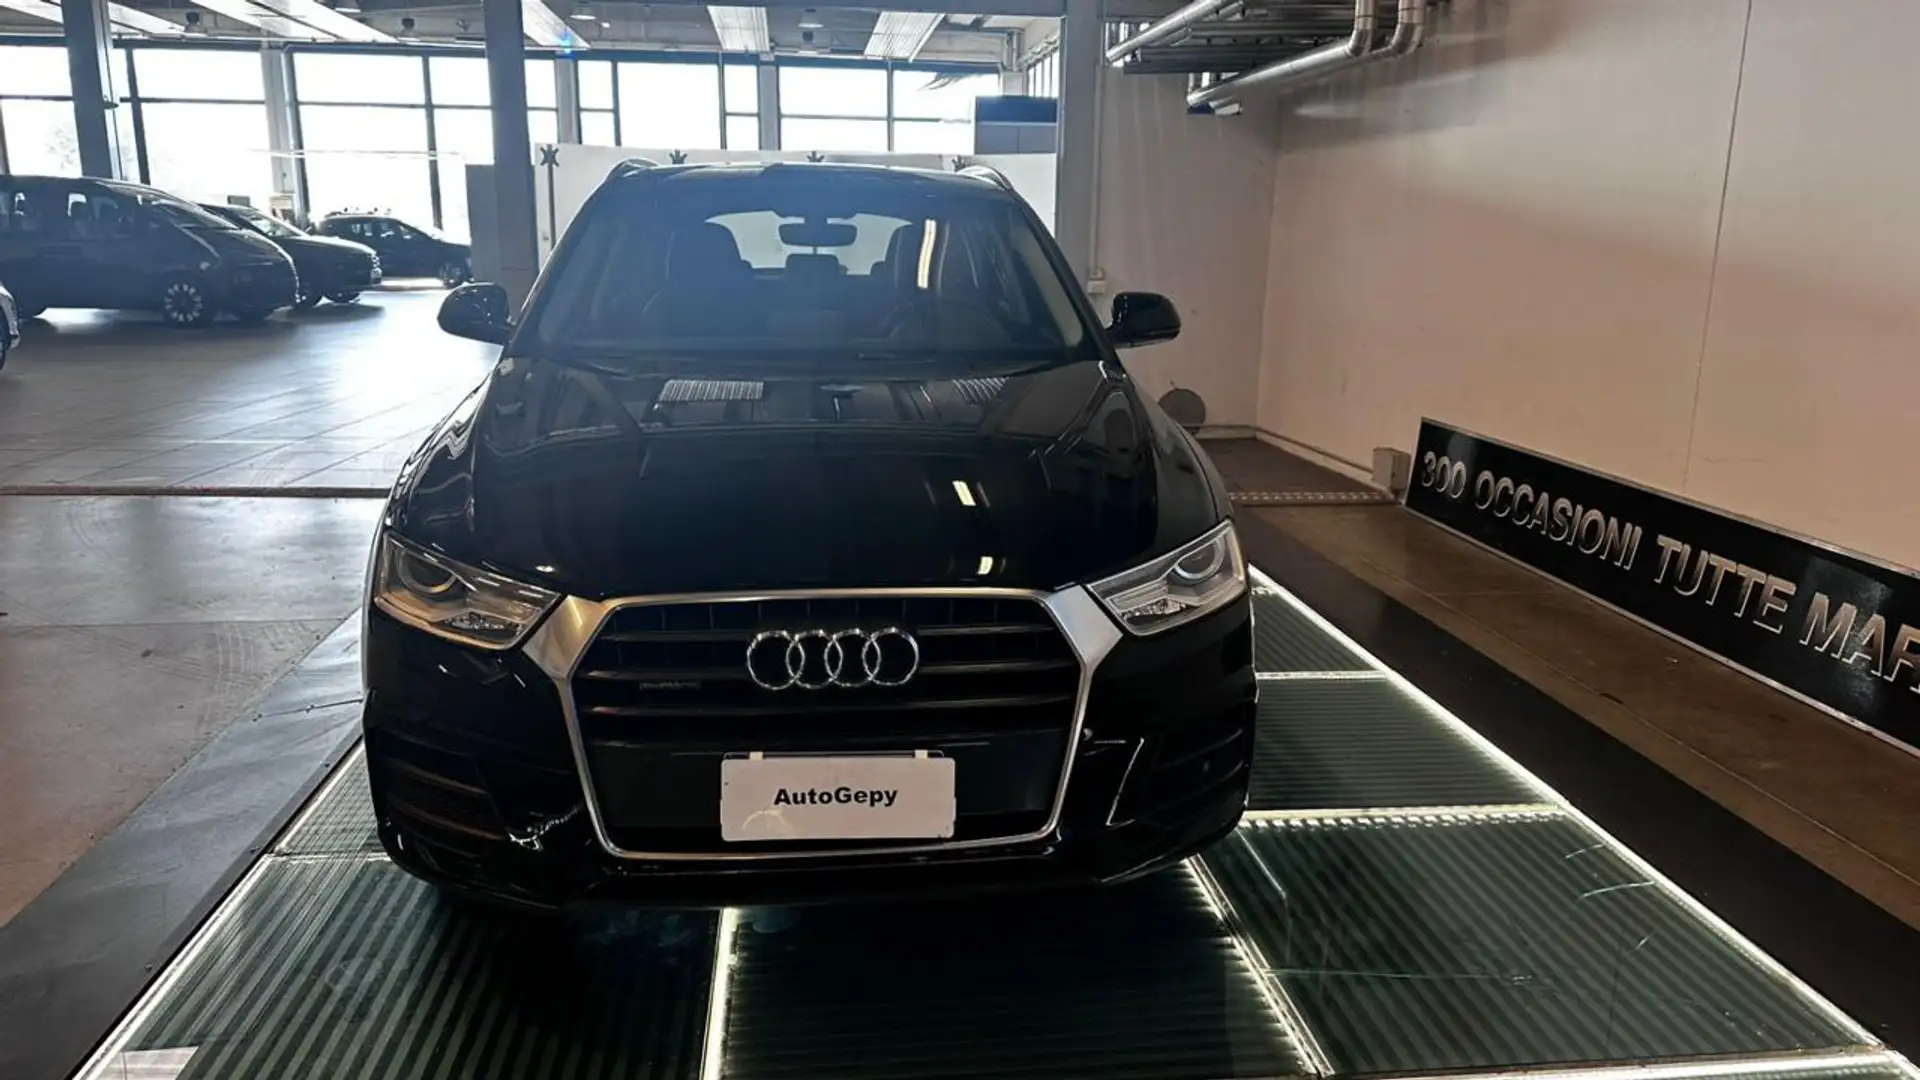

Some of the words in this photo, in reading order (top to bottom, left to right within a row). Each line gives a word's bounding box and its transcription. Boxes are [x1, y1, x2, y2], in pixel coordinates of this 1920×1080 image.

[1421, 451, 1467, 498] 300
[1474, 470, 1643, 570] OCCASIONI
[1653, 534, 1797, 634] TUTTE
[774, 787, 898, 806] AutoGepy
